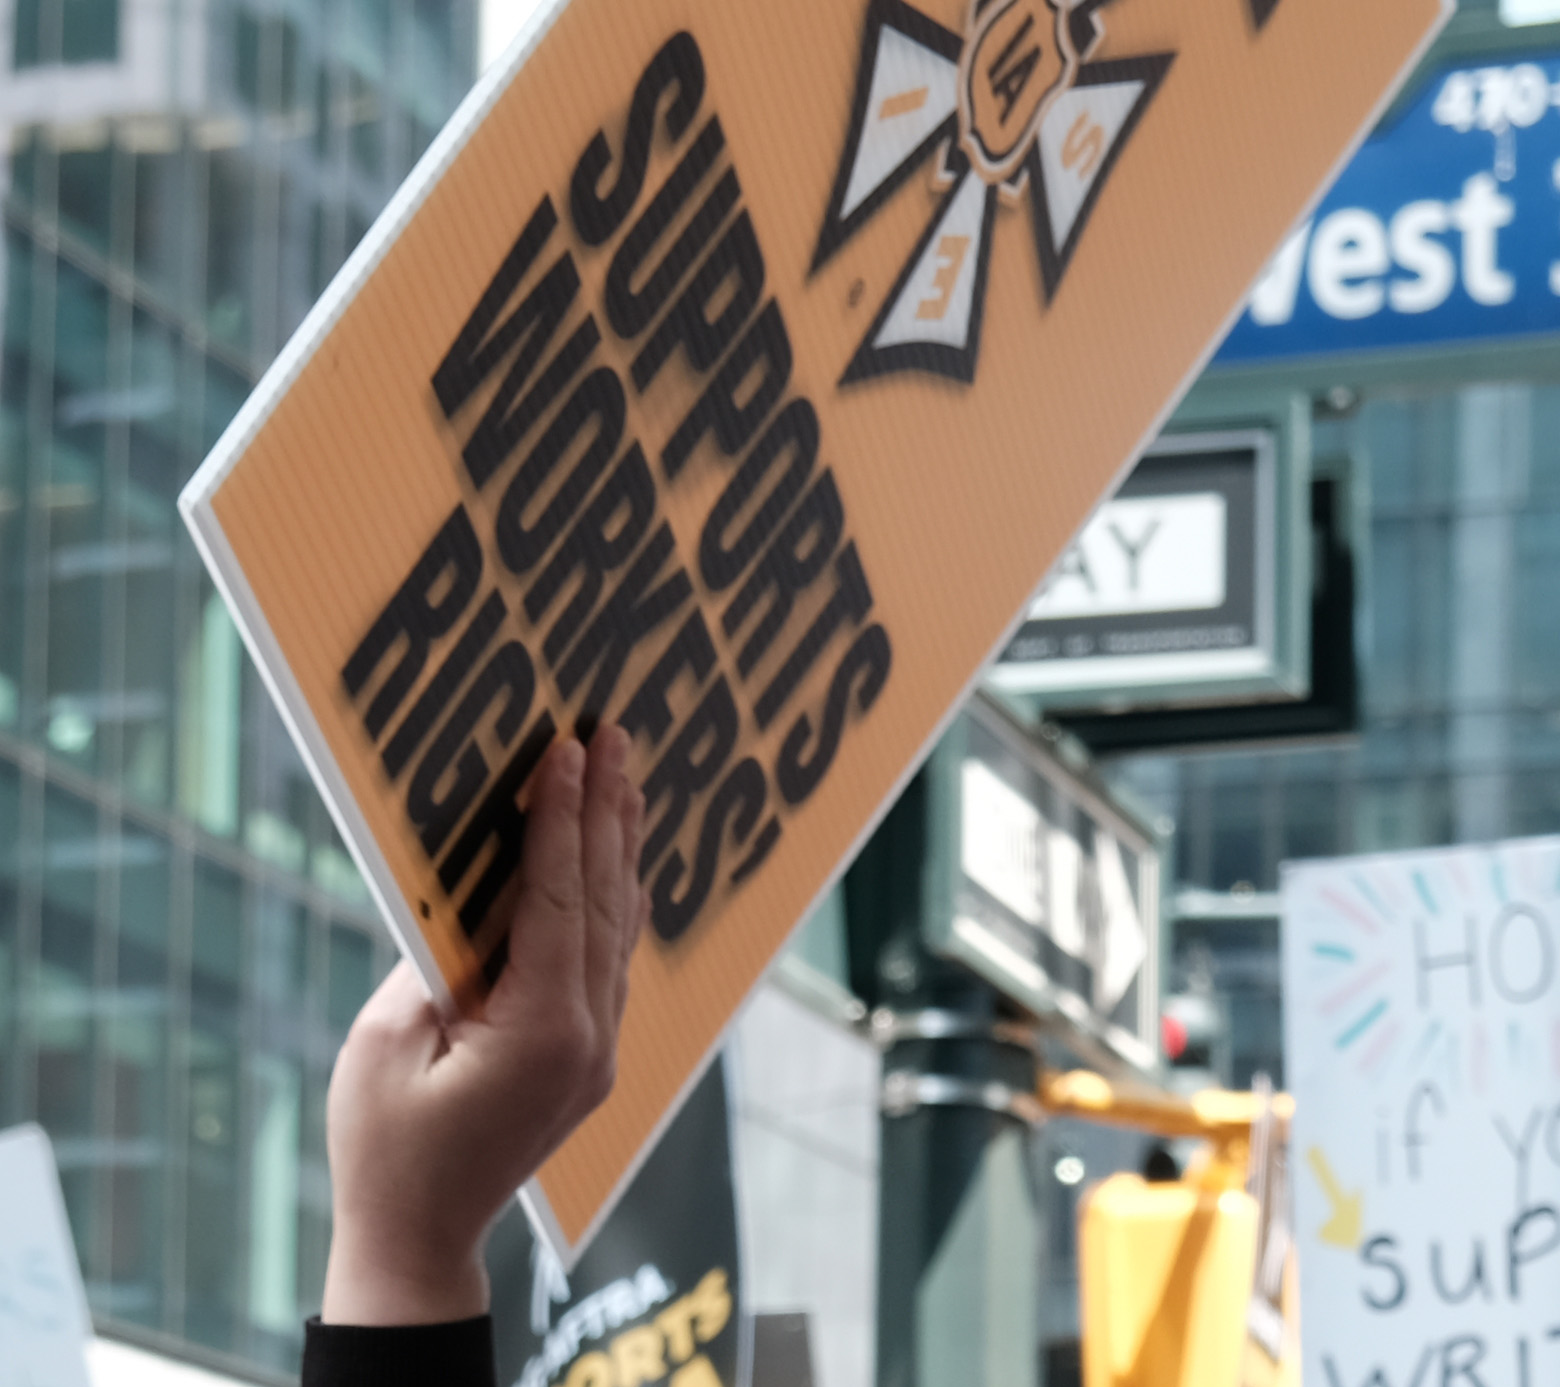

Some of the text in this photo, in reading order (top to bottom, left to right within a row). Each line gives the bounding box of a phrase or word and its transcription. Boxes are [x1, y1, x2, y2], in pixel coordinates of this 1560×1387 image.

[1249, 168, 1517, 328] est
[568, 29, 894, 814] SUPPORTS
[1374, 1082, 1446, 1186] if
